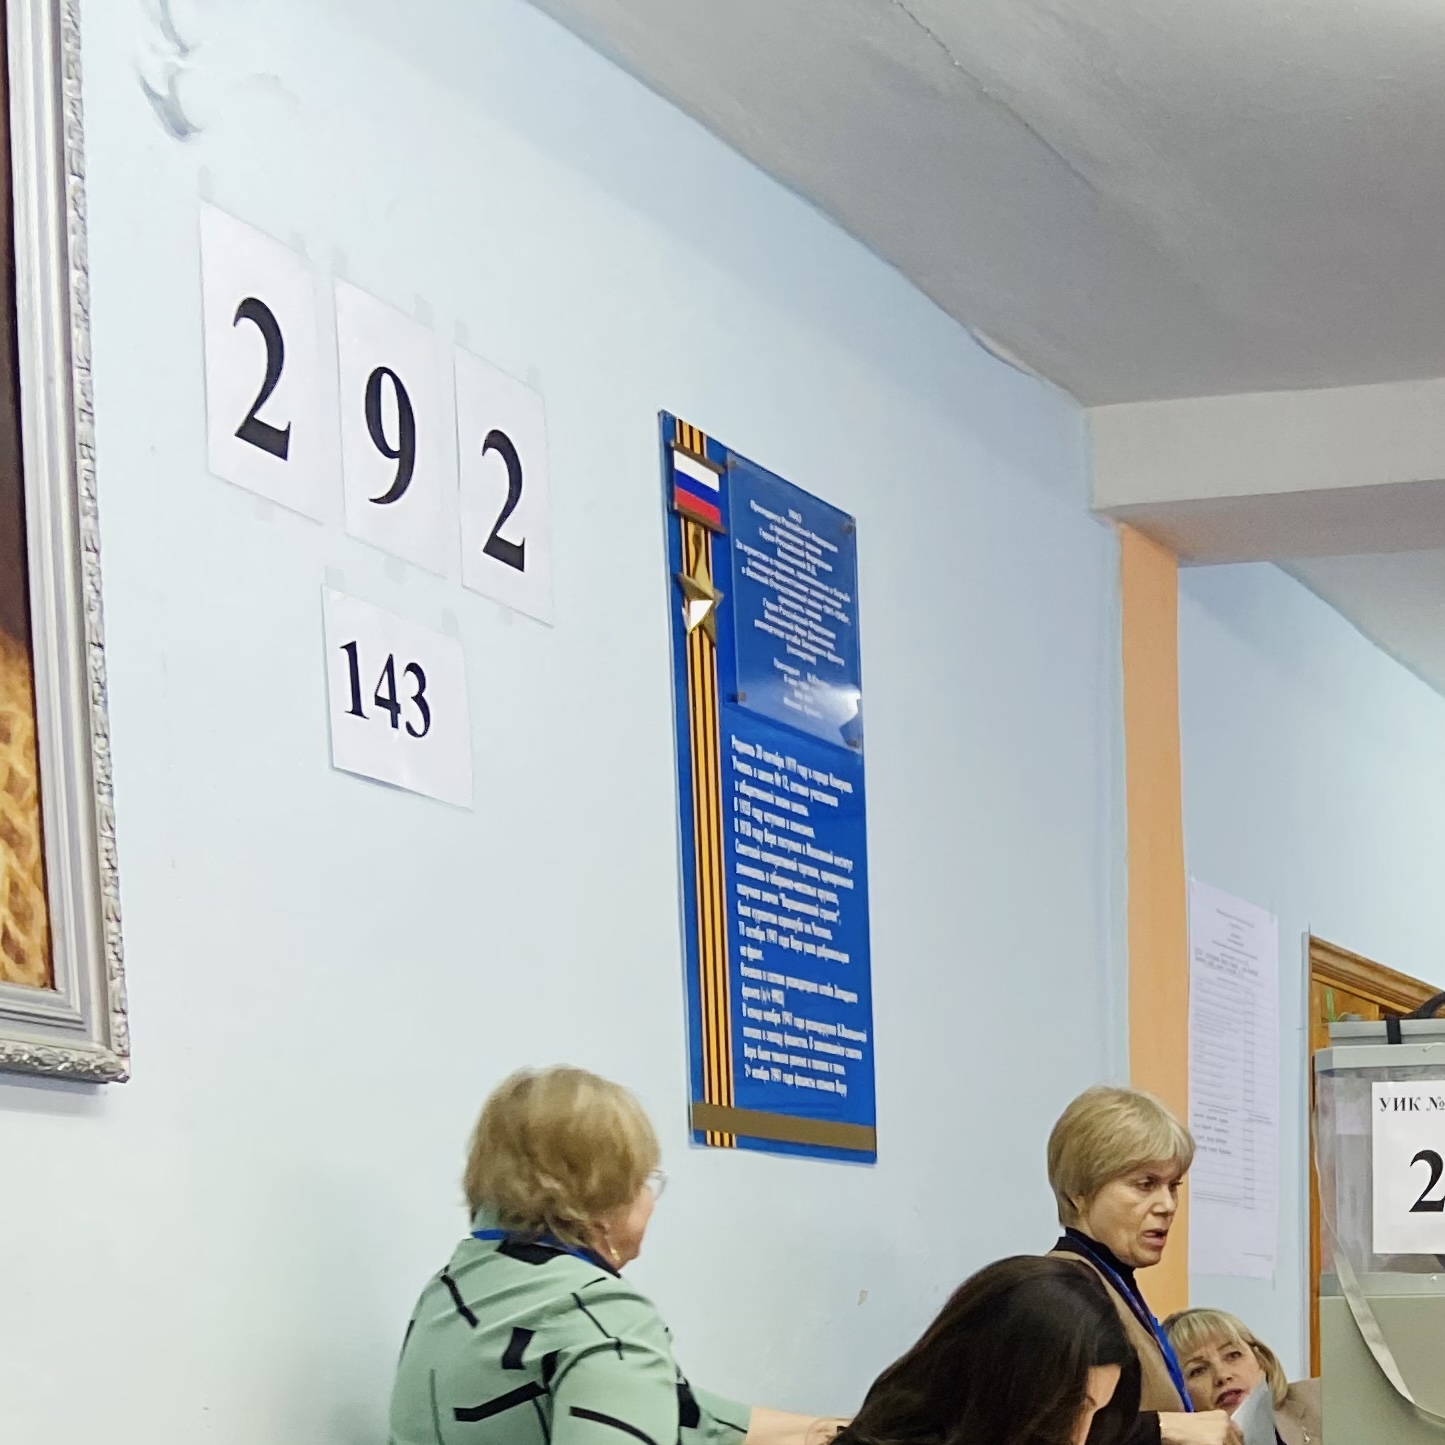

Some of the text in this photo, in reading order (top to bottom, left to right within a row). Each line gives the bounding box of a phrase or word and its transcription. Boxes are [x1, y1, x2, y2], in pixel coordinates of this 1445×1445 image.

[233, 296, 526, 573] 2 9 2
[339, 640, 432, 738] 143
[1378, 1096, 1422, 1112] УИК
[1425, 1095, 1445, 1112] №
